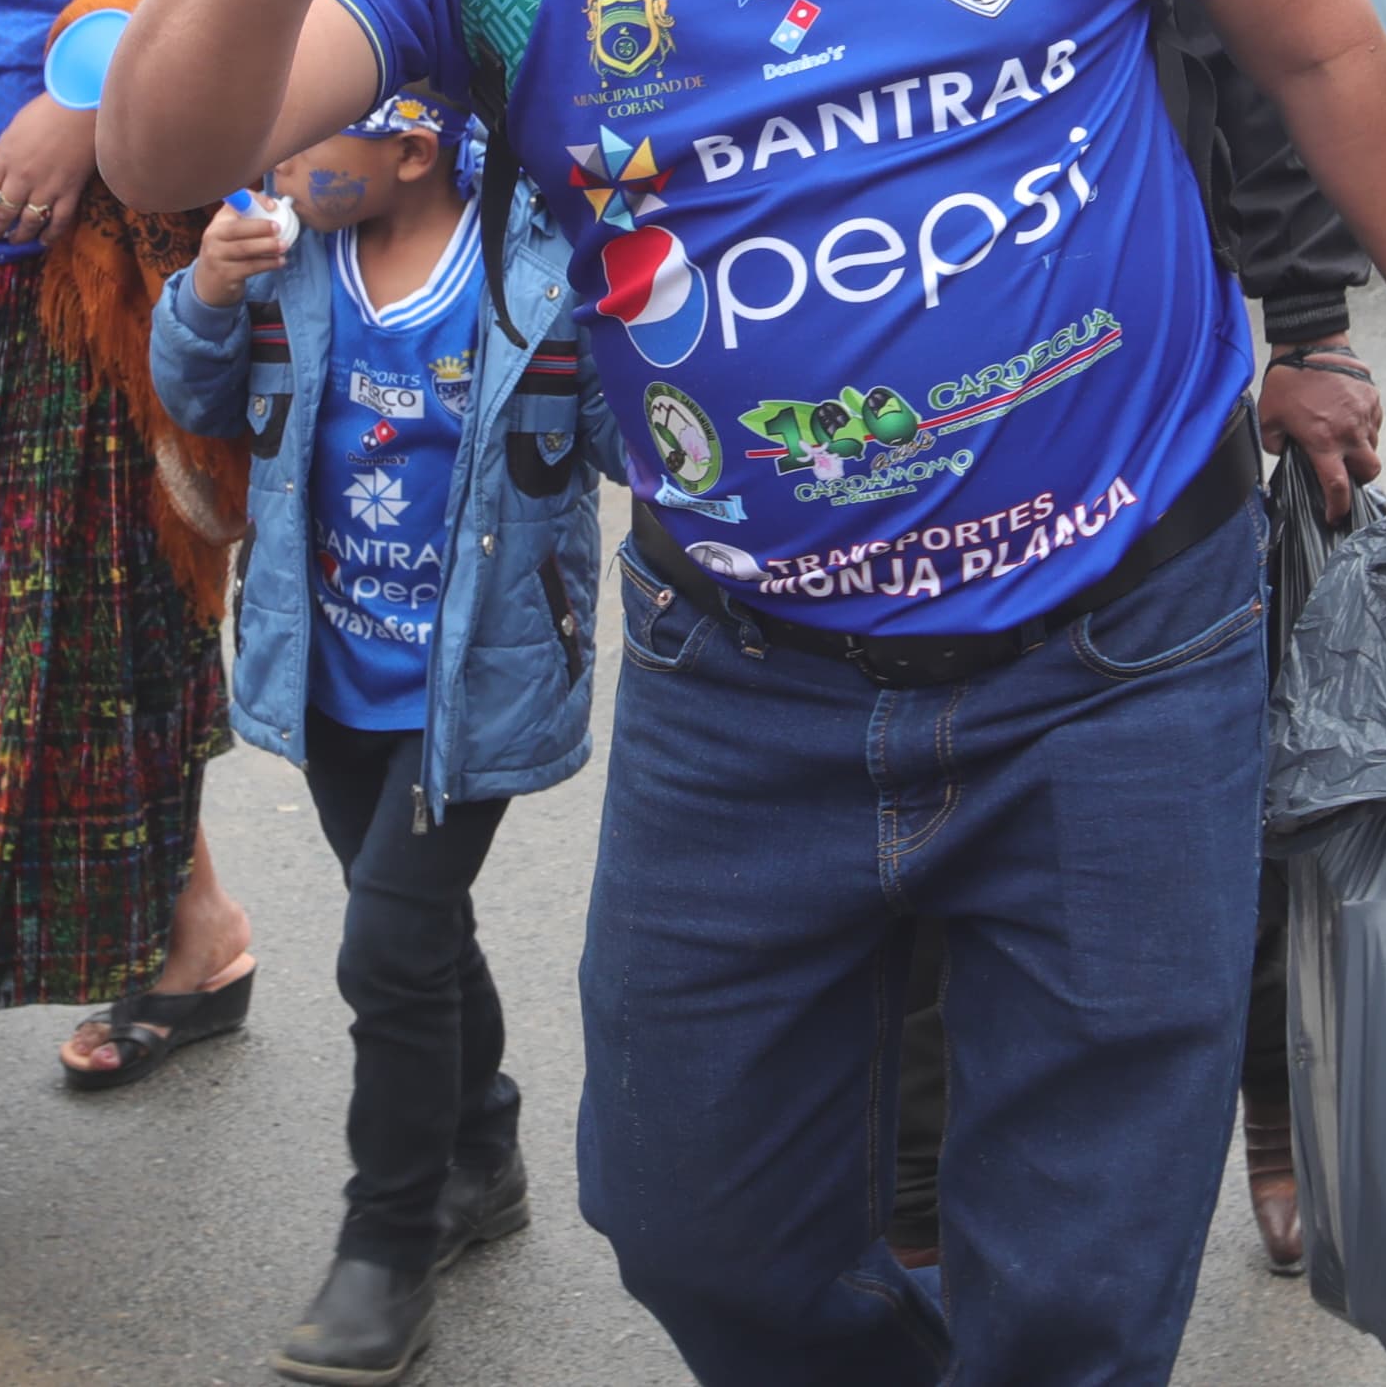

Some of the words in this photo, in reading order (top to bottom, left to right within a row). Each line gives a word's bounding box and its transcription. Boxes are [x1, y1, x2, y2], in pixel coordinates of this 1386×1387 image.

[762, 44, 846, 81] Domino's
[573, 79, 682, 108] MUNICIPALIDAD
[684, 74, 706, 89] DE
[607, 96, 665, 119] COBÁN
[693, 38, 1078, 184] BANTRAB
[716, 125, 1091, 350] pepsi
[927, 308, 1122, 411] CARDEGUA
[794, 448, 975, 503] CARDAMOMO
[830, 495, 848, 507] DE
[850, 484, 918, 503] GUATEMALA
[315, 517, 443, 571] BANTRA
[351, 574, 438, 610] pep
